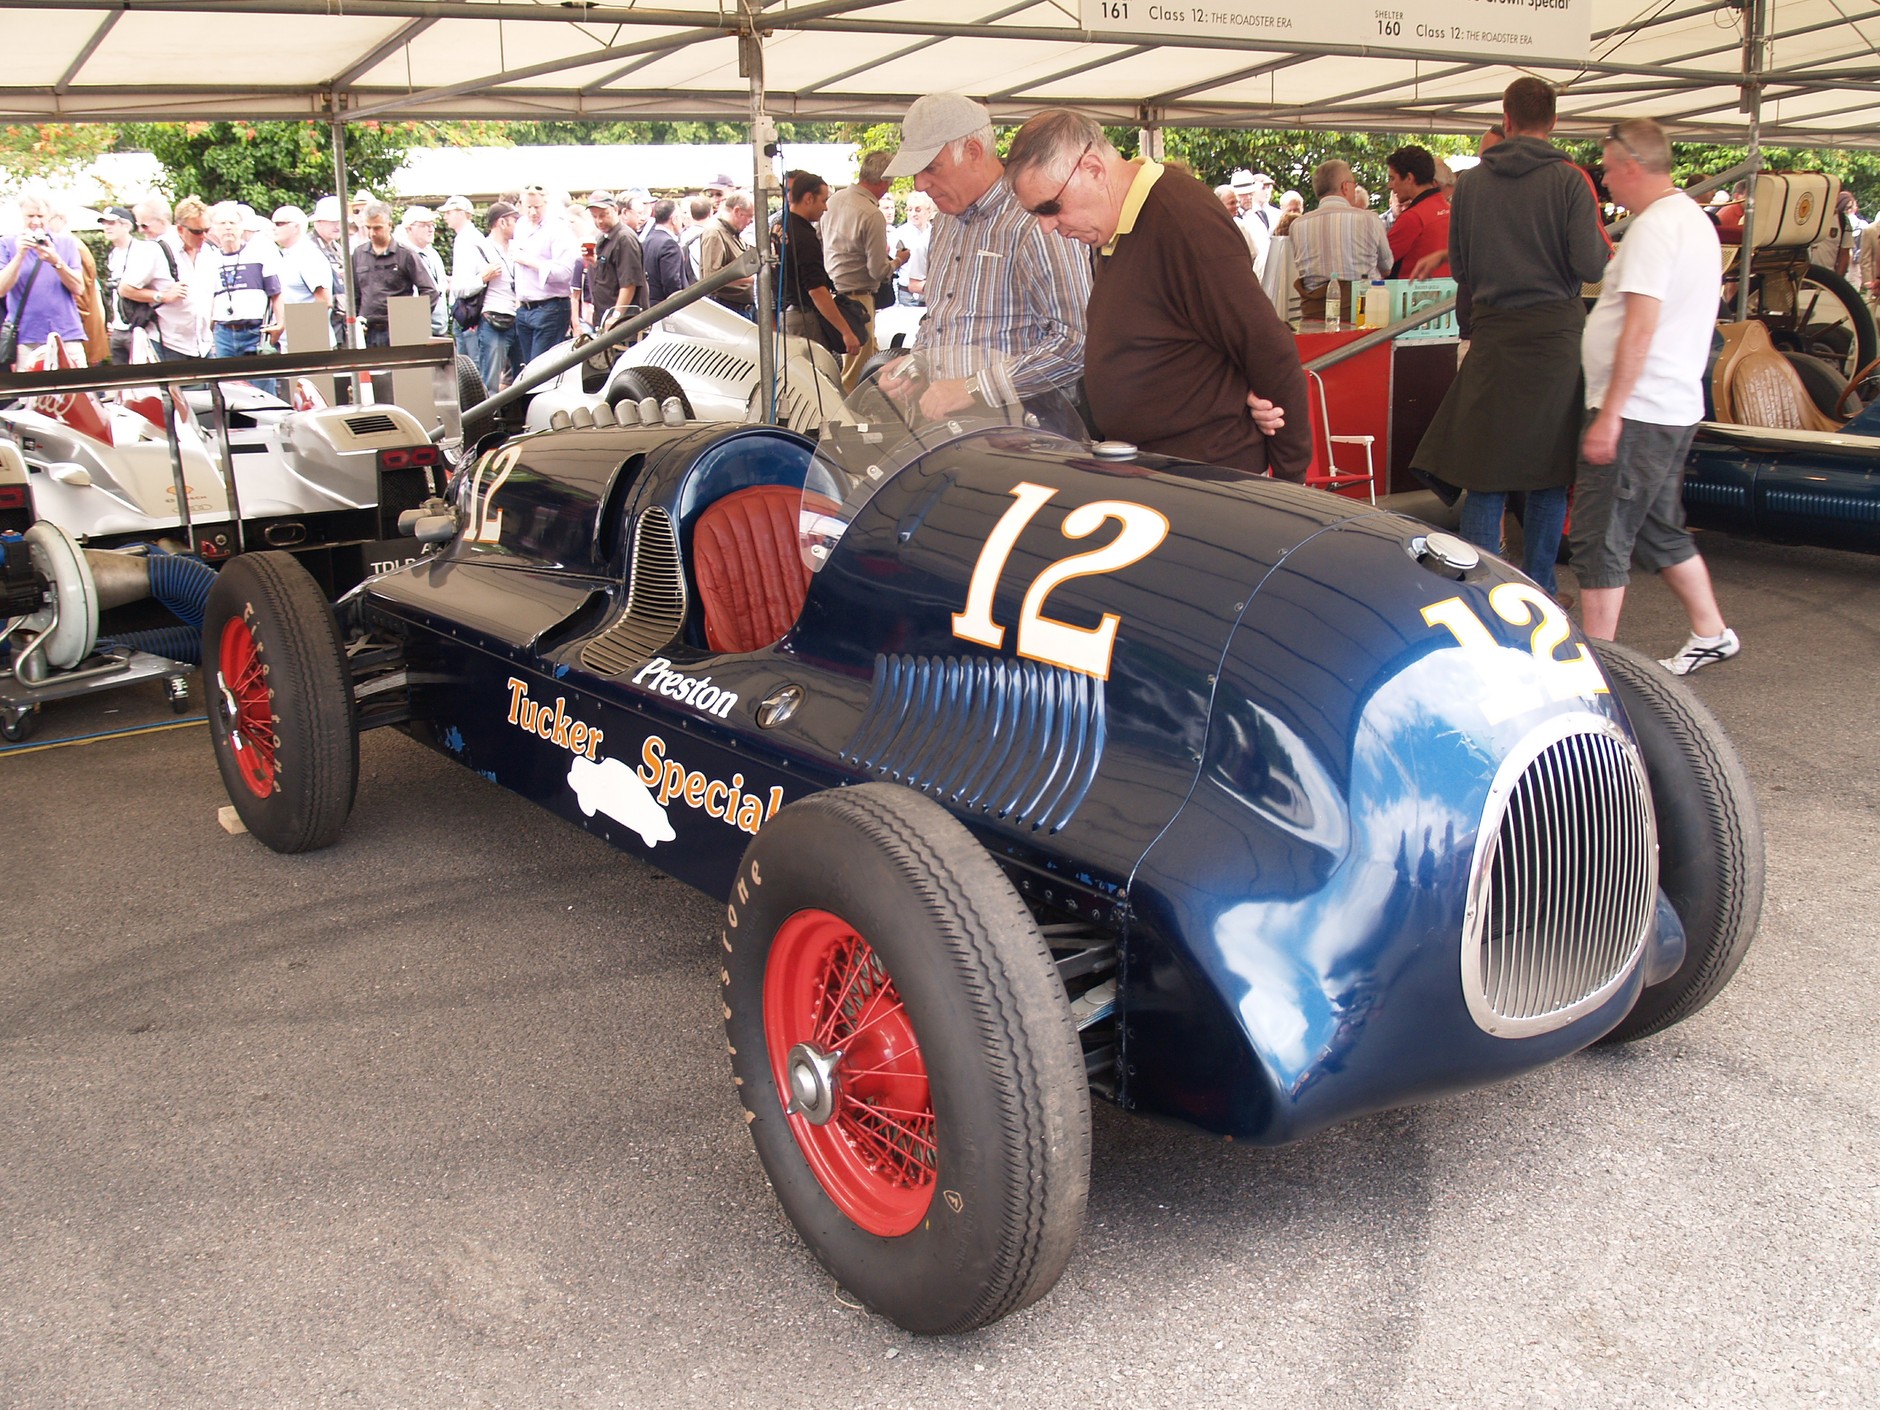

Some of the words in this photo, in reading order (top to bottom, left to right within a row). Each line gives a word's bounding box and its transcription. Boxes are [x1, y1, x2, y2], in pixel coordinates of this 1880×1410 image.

[1101, 2, 1128, 19] 161
[1149, 6, 1185, 22] Class
[1191, 9, 1208, 23] 12:
[1211, 12, 1228, 24] THE
[1229, 14, 1274, 28] ROADSTER
[1276, 17, 1293, 29] ERA
[1375, 10, 1403, 20] SHELTER
[1377, 20, 1401, 36] 160
[1416, 24, 1445, 39] Class
[1450, 27, 1464, 40] 12:
[1466, 30, 1480, 41] THE
[1481, 31, 1518, 44] ROADSTER
[1519, 34, 1532, 45] ERA
[463, 444, 522, 543] 12
[951, 481, 1170, 681] 12
[632, 657, 739, 719] Preston
[1419, 582, 1610, 727] 12
[507, 676, 604, 761] Tucker
[637, 735, 784, 836] Special
